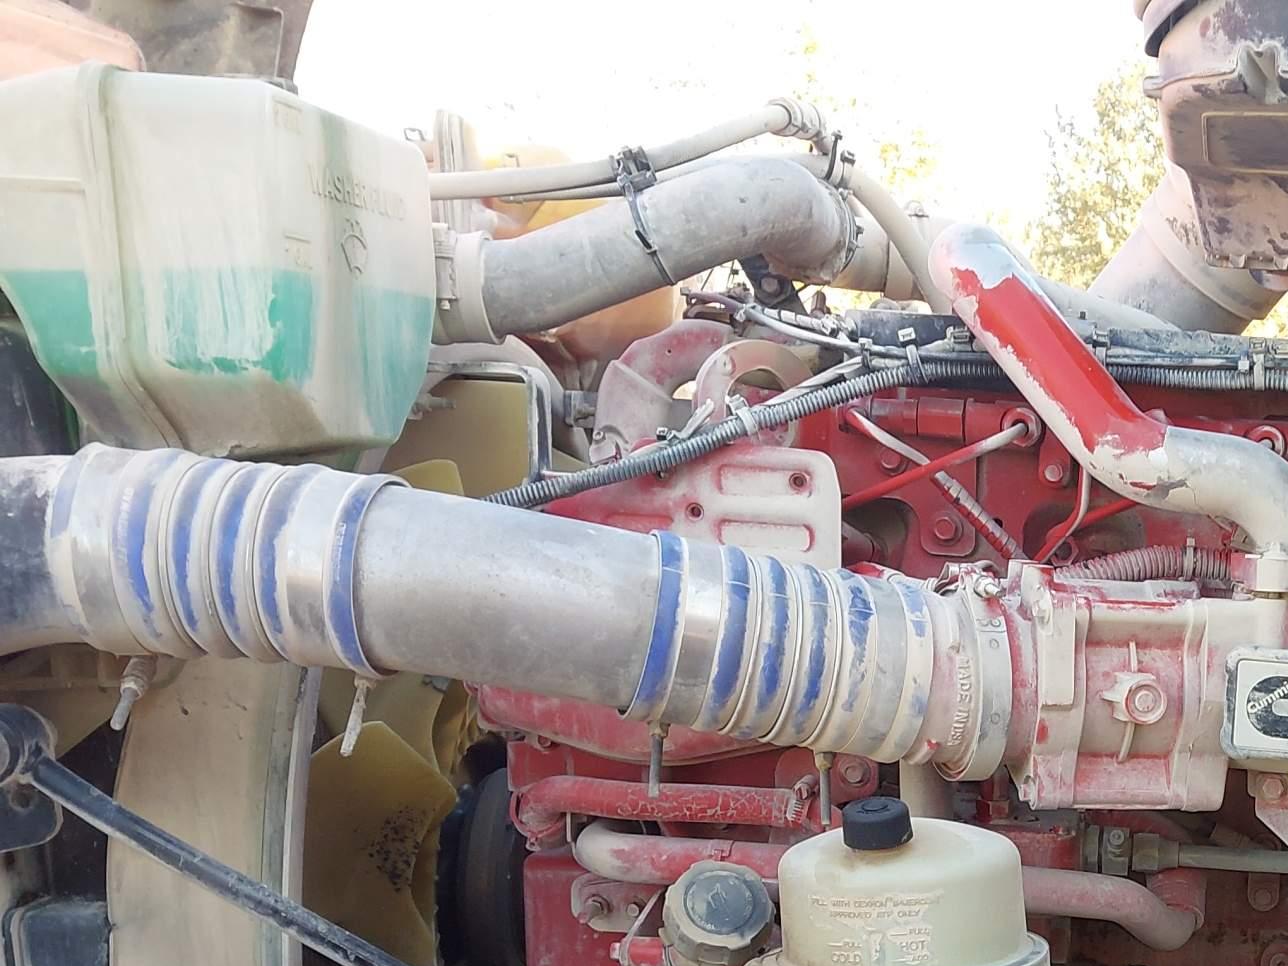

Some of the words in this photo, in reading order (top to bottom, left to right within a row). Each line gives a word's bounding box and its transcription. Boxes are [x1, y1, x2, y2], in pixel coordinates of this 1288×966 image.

[308, 161, 368, 210] WASHER
[957, 657, 973, 704] MADE
[954, 708, 969, 722] IN
[897, 909, 920, 919] ONLY
[900, 940, 926, 951] HOT
[831, 952, 862, 964] COLD
